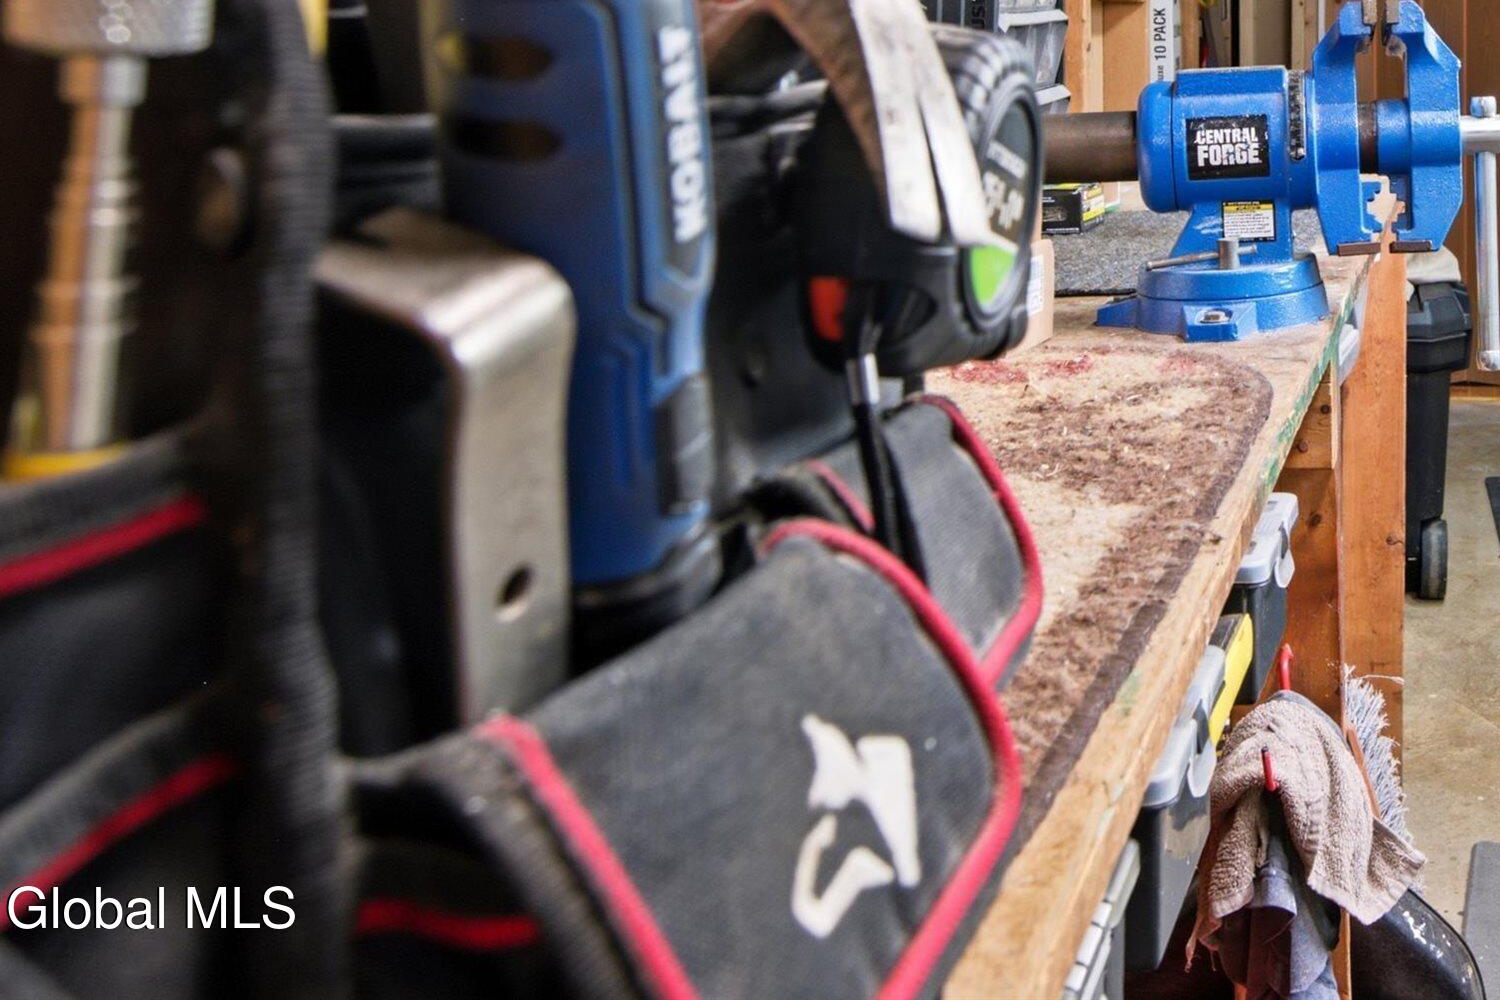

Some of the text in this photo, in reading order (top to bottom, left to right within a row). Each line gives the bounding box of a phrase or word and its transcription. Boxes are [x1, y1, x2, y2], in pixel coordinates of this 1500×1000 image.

[1153, 8, 1167, 41] PACK
[1154, 45, 1167, 60] 10
[659, 26, 707, 244] KOBALT
[1194, 127, 1259, 145] CENTRAL
[1197, 142, 1262, 167] FORGE
